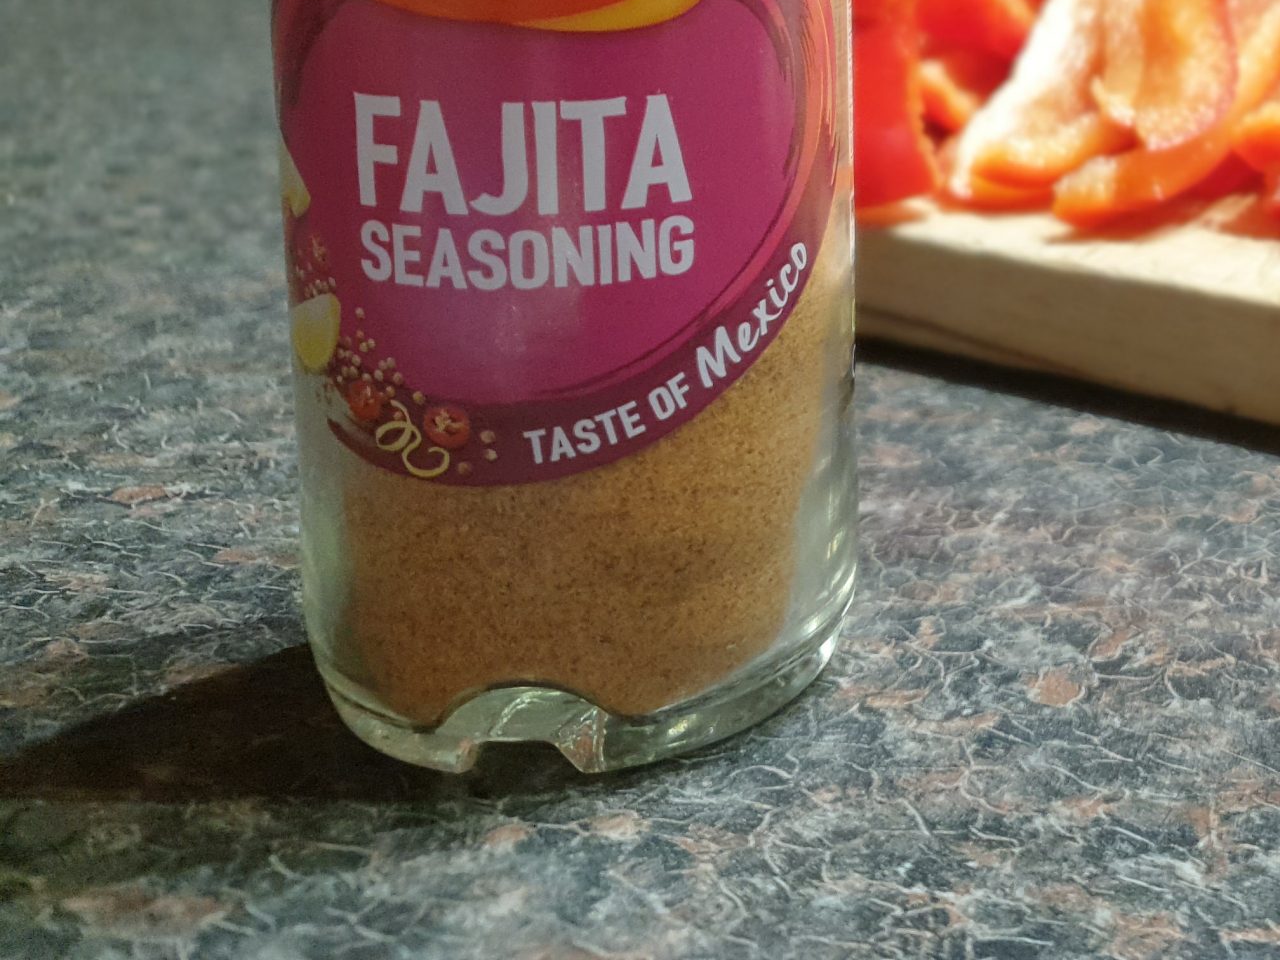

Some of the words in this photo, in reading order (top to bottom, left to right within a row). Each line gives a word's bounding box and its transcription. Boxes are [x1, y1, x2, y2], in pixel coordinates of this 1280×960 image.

[352, 91, 693, 216] FAJITA
[360, 215, 695, 291] SEASONING
[523, 399, 647, 465] TASTE
[647, 372, 690, 422] OF
[696, 241, 807, 388] Mexico
